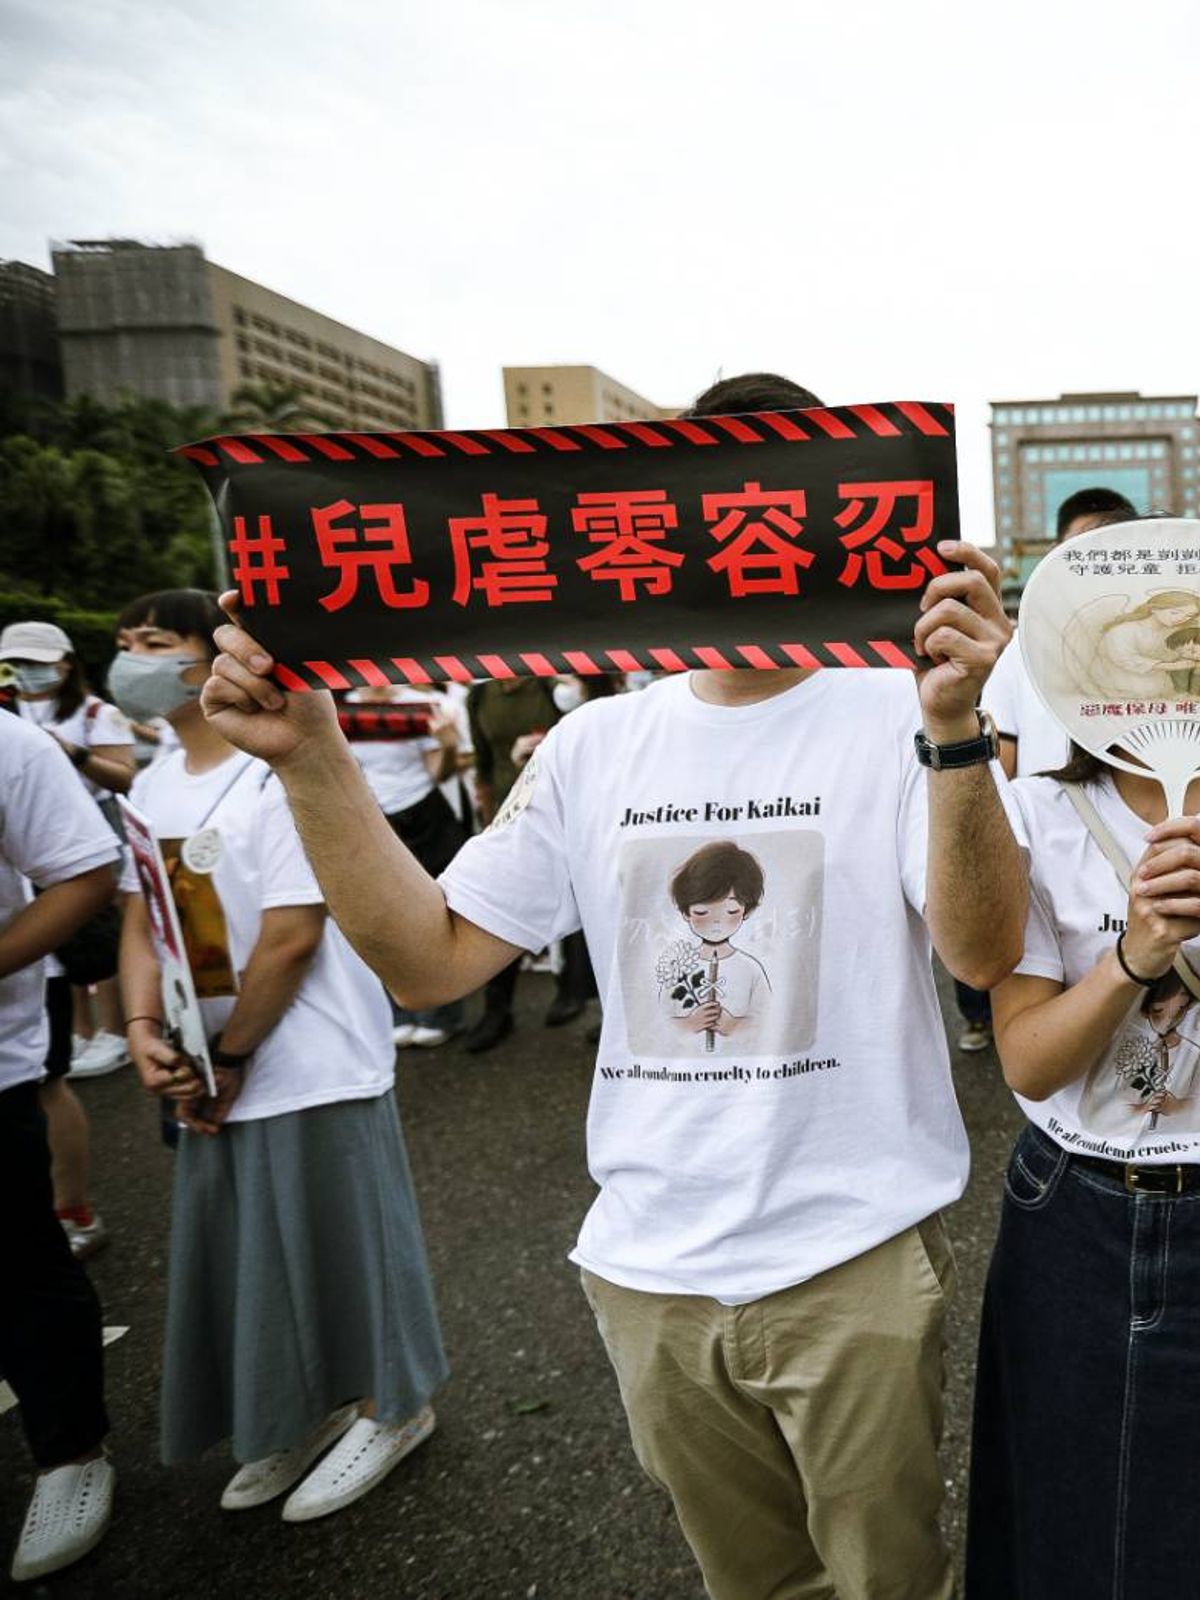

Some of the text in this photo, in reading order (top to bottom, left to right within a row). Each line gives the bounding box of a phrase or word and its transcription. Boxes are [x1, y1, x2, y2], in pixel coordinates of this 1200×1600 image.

[229, 478, 946, 611] #兒虐零容忍
[1069, 562, 1161, 576] 守護兒童
[620, 797, 821, 827] Justice For Kaikai
[600, 1067, 624, 1081] We
[627, 1065, 641, 1079] all
[694, 1066, 752, 1083] cruelty
[756, 1066, 770, 1079] to
[773, 1057, 841, 1079] children.
